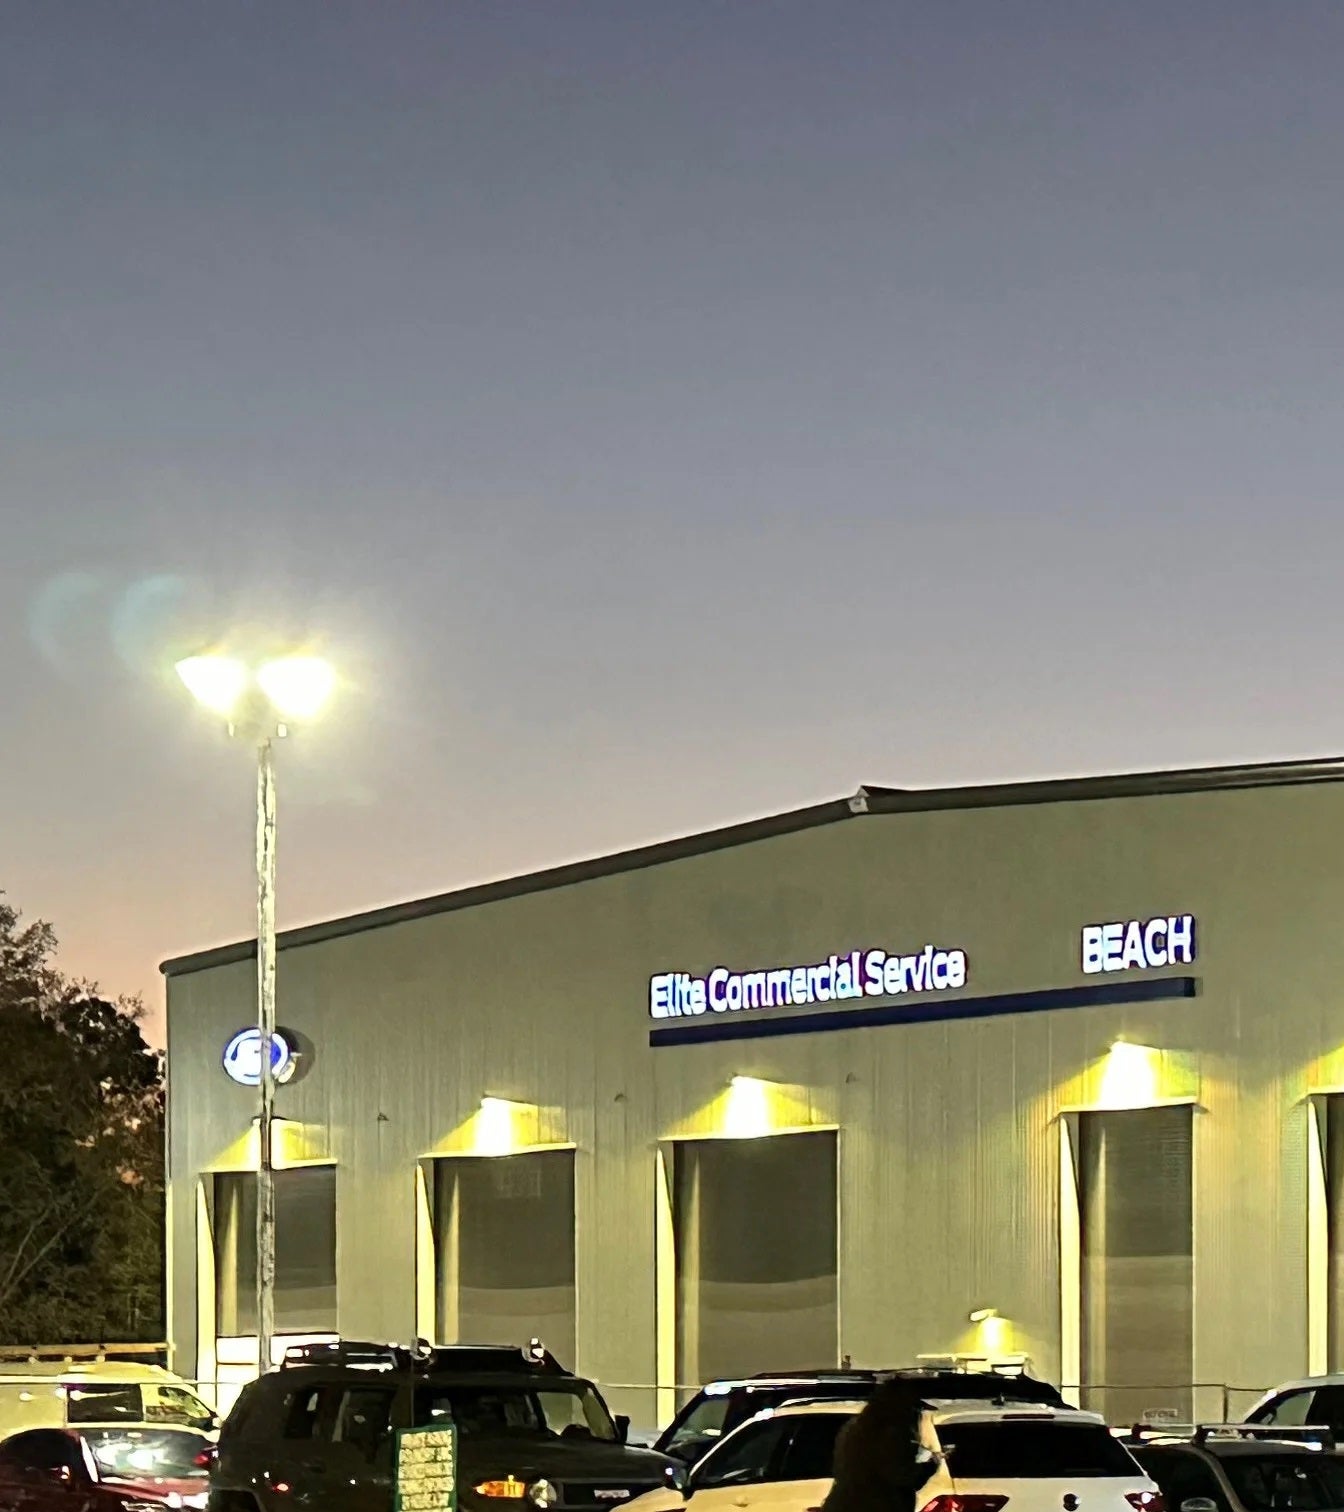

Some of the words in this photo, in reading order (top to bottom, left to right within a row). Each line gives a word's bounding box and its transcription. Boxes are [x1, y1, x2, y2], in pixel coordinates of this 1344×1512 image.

[1081, 914, 1195, 975] BEACH
[649, 972, 707, 1019] Elite
[708, 950, 863, 1013] Commercial
[864, 944, 967, 996] Service
